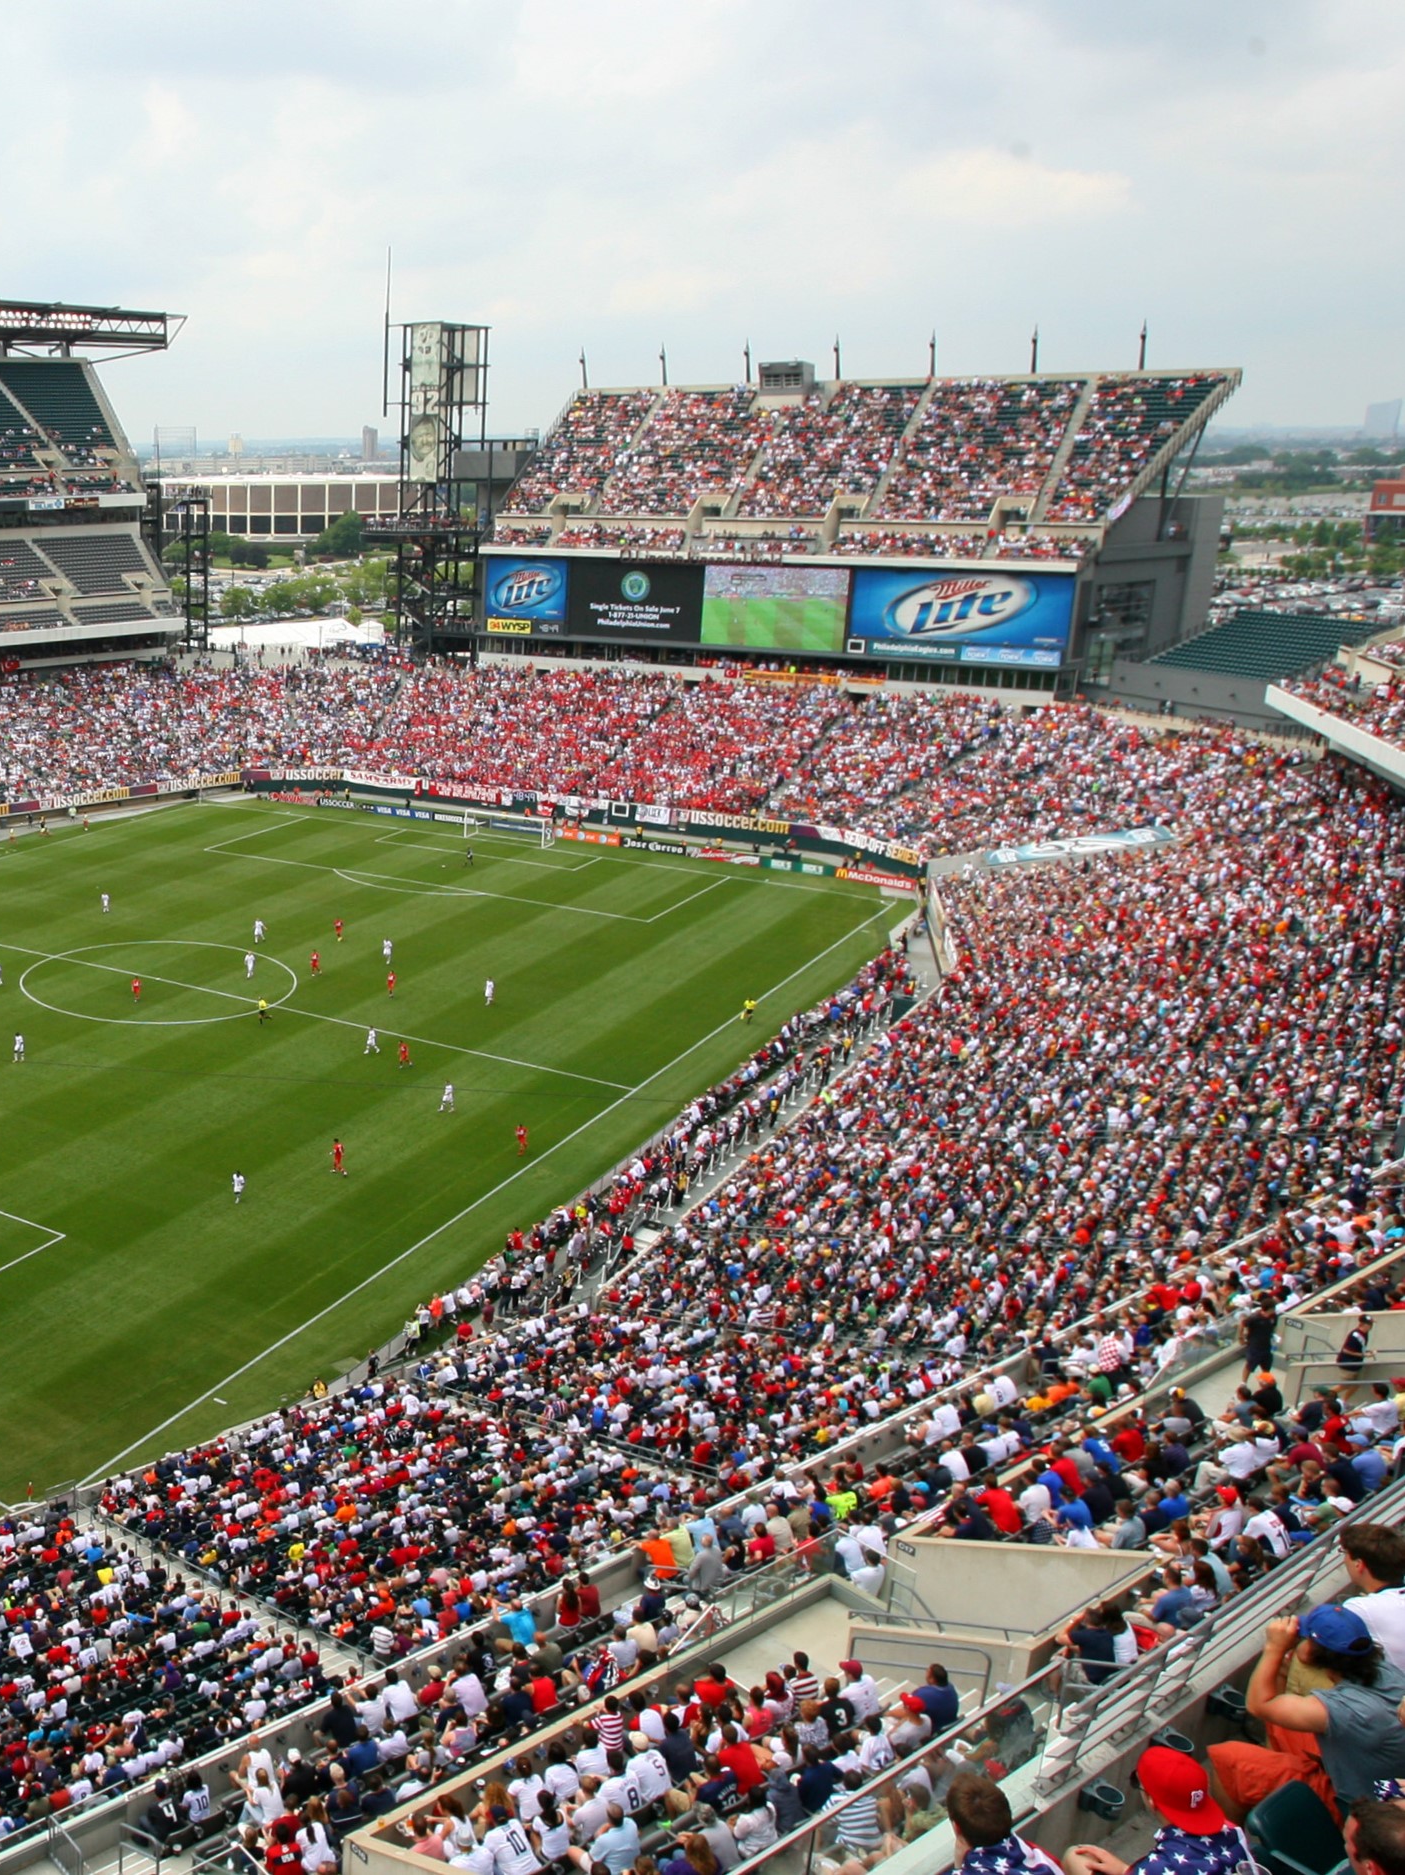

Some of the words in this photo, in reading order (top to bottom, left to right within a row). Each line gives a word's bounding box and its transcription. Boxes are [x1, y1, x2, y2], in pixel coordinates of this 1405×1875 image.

[411, 390, 439, 415] 92
[501, 577, 552, 609] Lite
[929, 578, 993, 600] Miller
[659, 606, 674, 614] June
[907, 589, 1014, 635] Lite
[169, 771, 241, 793] ussoccer.com
[53, 786, 131, 808] ussoccer.com
[377, 806, 392, 815] VISA
[396, 808, 411, 817] VISA
[414, 811, 430, 820] VISA
[689, 810, 790, 835] ussoccer.com
[648, 841, 683, 854] Cuervo
[885, 844, 919, 866] SERIES
[848, 872, 912, 889] McDonald's
[897, 1541, 914, 1553] C17
[834, 1708, 848, 1727] 3
[652, 1758, 666, 1777] 5
[196, 1795, 209, 1811] 10
[627, 1786, 640, 1810] 8
[1190, 1789, 1203, 1808] P
[162, 1803, 177, 1823] 4
[505, 1830, 527, 1856] 10
[281, 1853, 295, 1864] USA
